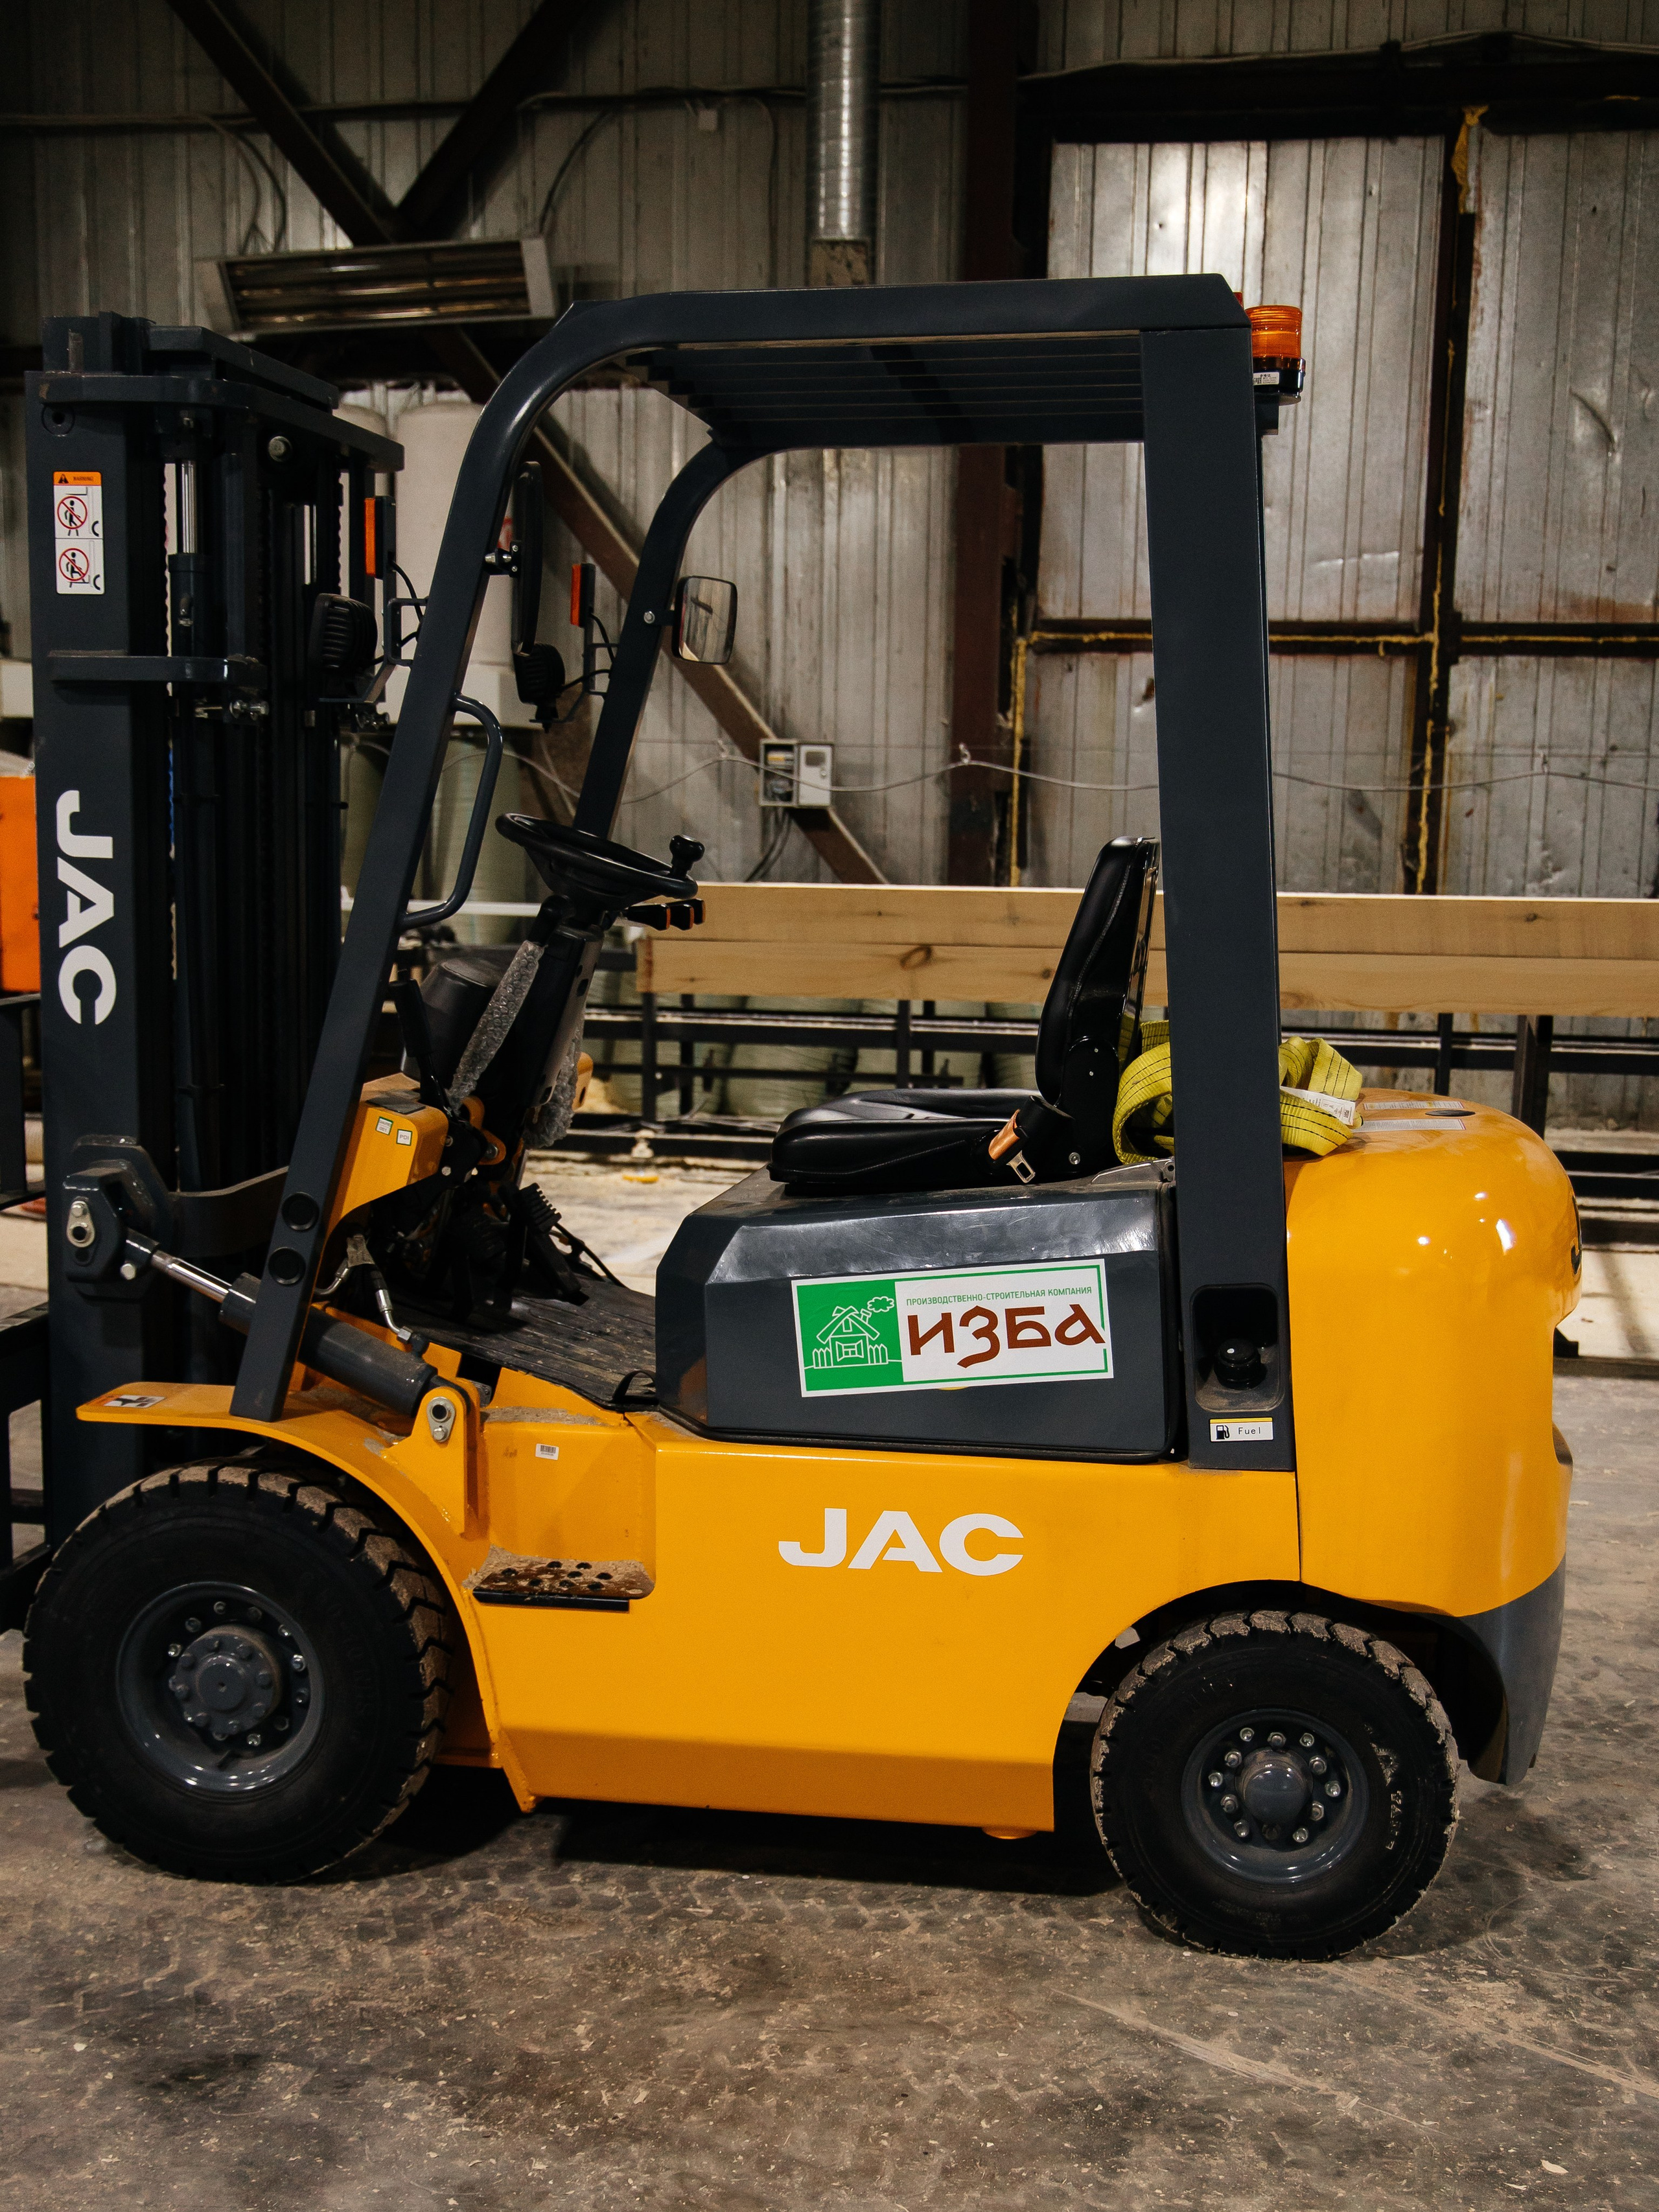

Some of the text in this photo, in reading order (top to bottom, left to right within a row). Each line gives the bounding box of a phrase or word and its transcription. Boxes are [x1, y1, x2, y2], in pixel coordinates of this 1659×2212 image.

[56, 789, 117, 1025] JAC
[906, 1286, 1093, 1306] ПРОИЗВОДСТВЕННО-СТРОИТЕЛЬНАЯ КОМПАНИЯ
[907, 1303, 1106, 1369] ИЗБА
[1238, 1426, 1261, 1435] Fuel
[778, 1508, 1025, 1576] JAC
